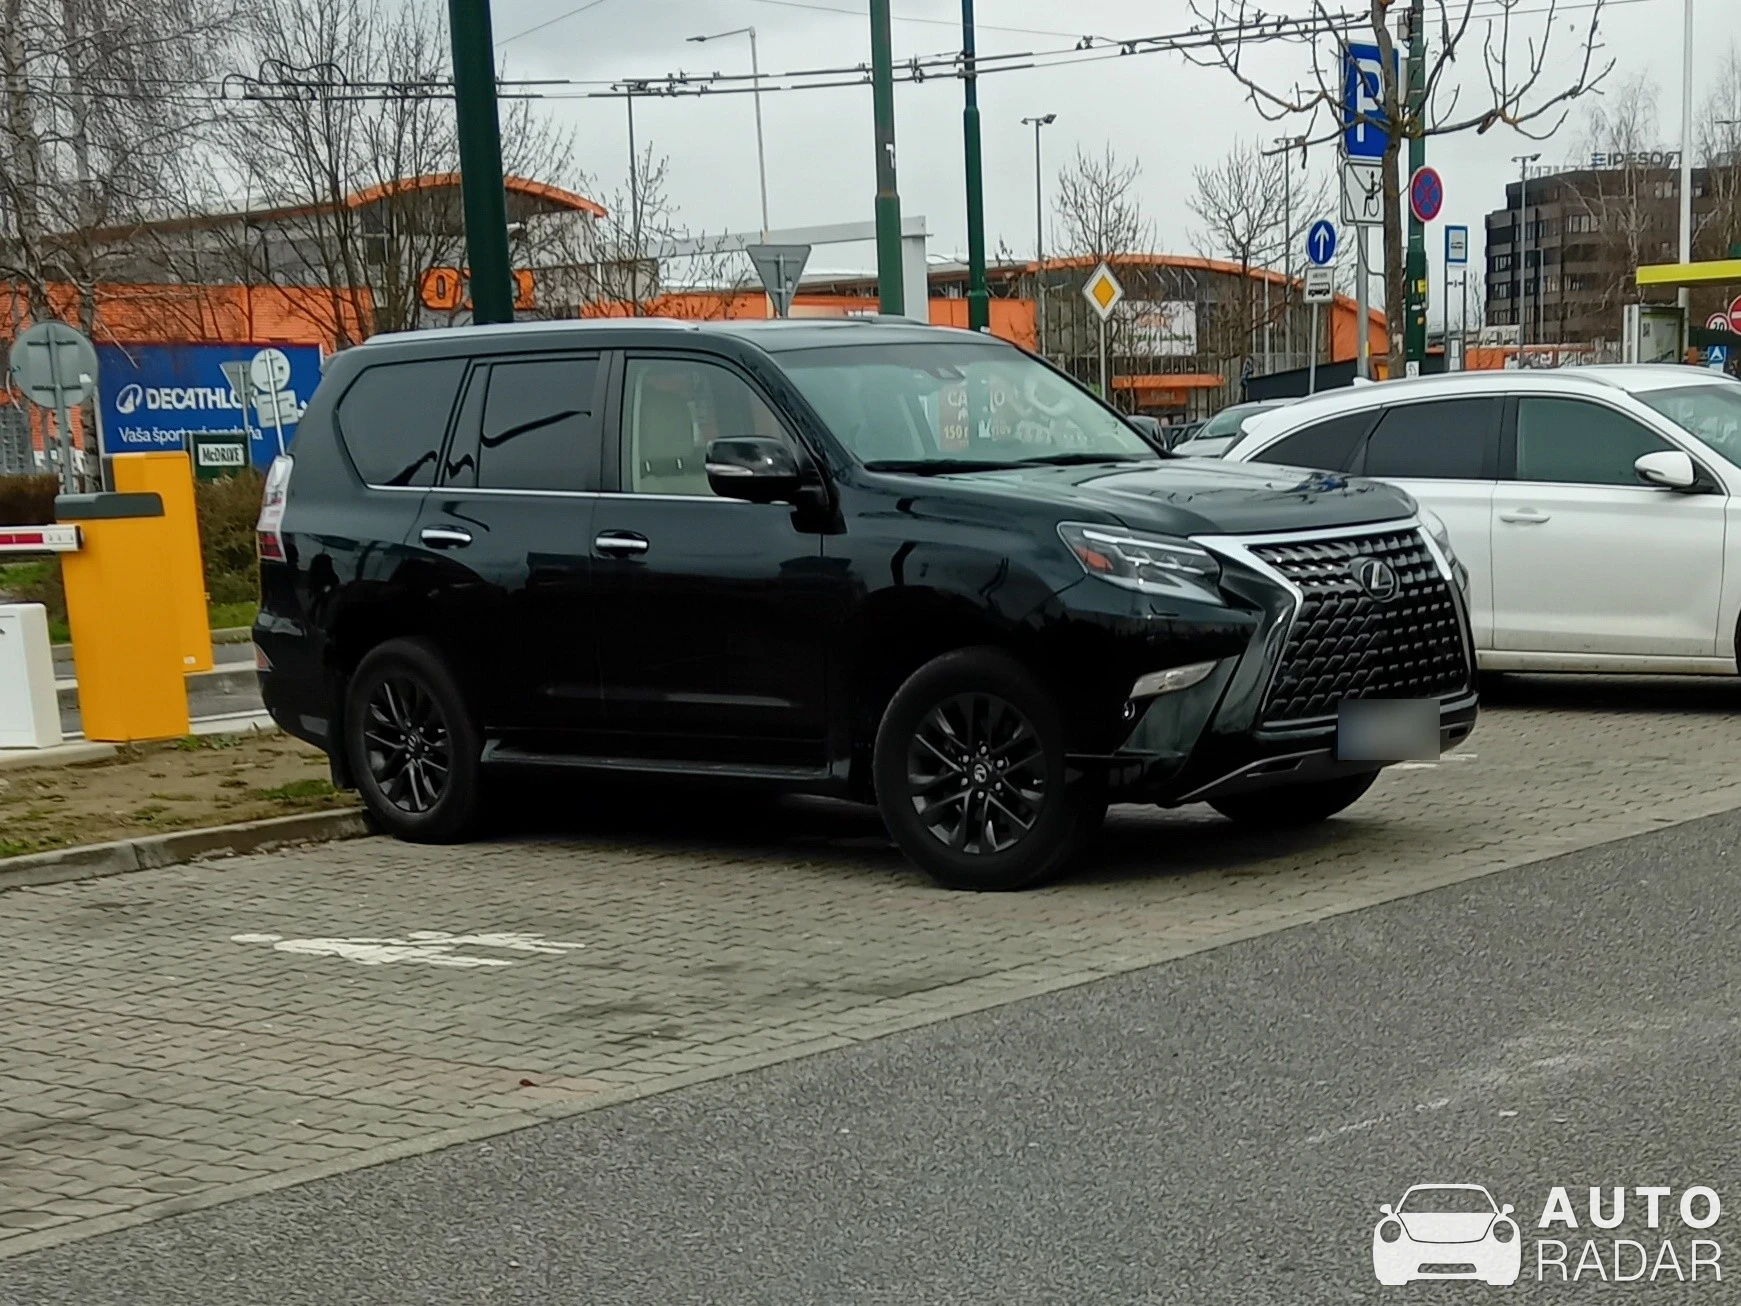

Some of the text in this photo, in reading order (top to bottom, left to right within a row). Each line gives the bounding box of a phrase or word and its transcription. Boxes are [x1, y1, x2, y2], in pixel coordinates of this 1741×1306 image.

[1356, 58, 1386, 142] P
[421, 267, 536, 310] OI
[146, 387, 259, 411] DECATHLO
[118, 427, 151, 443] Vaša
